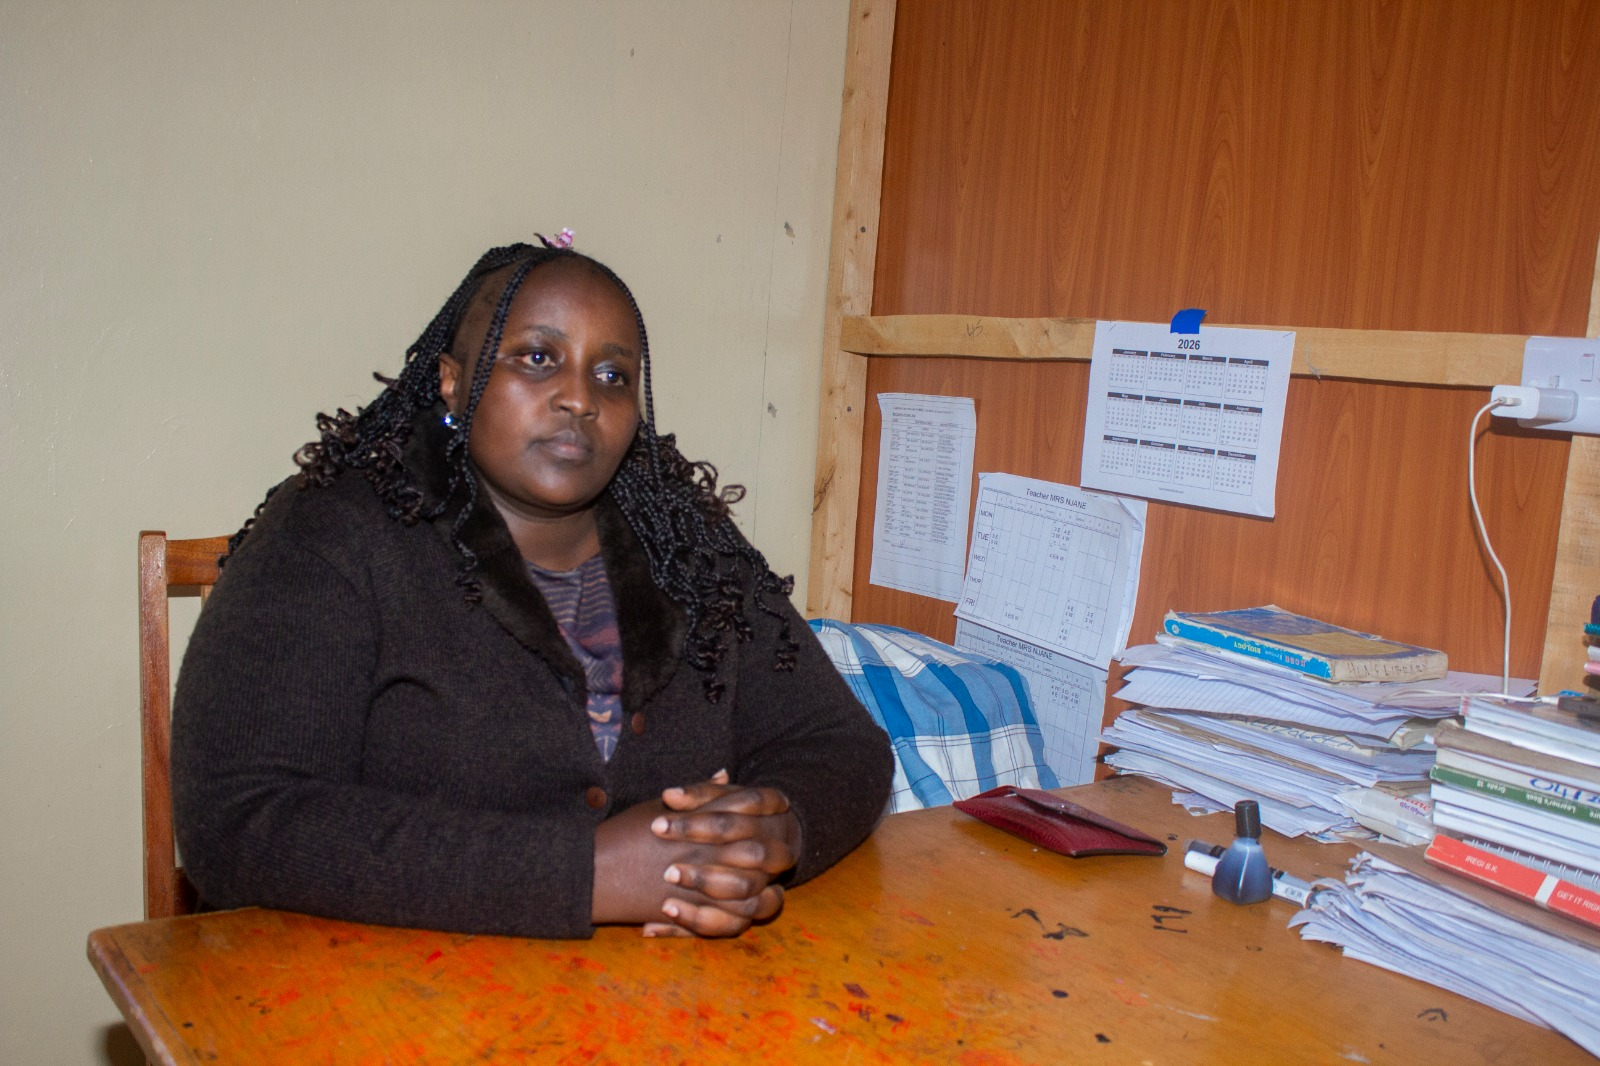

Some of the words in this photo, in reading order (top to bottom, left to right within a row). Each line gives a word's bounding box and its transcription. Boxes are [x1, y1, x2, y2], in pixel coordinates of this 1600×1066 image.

[1177, 338, 1201, 351] 2026
[1025, 488, 1050, 501] Teacher
[1050, 494, 1065, 504] MRS
[1065, 498, 1087, 510] NJANE
[979, 510, 993, 518] MON
[977, 531, 990, 541] TUE
[973, 554, 986, 563] WED
[964, 597, 976, 607] FRI
[997, 634, 1019, 647] Teacher
[1018, 643, 1032, 654] MRS
[1032, 648, 1053, 660] NJANE
[1233, 641, 1261, 655] BIOLOGY
[1486, 781, 1507, 793] Grade
[1525, 793, 1543, 805] Book
[1543, 796, 1576, 814] Learner's
[1464, 854, 1485, 870] IREGI
[1556, 889, 1575, 902] GET
[1574, 895, 1584, 906] IT
